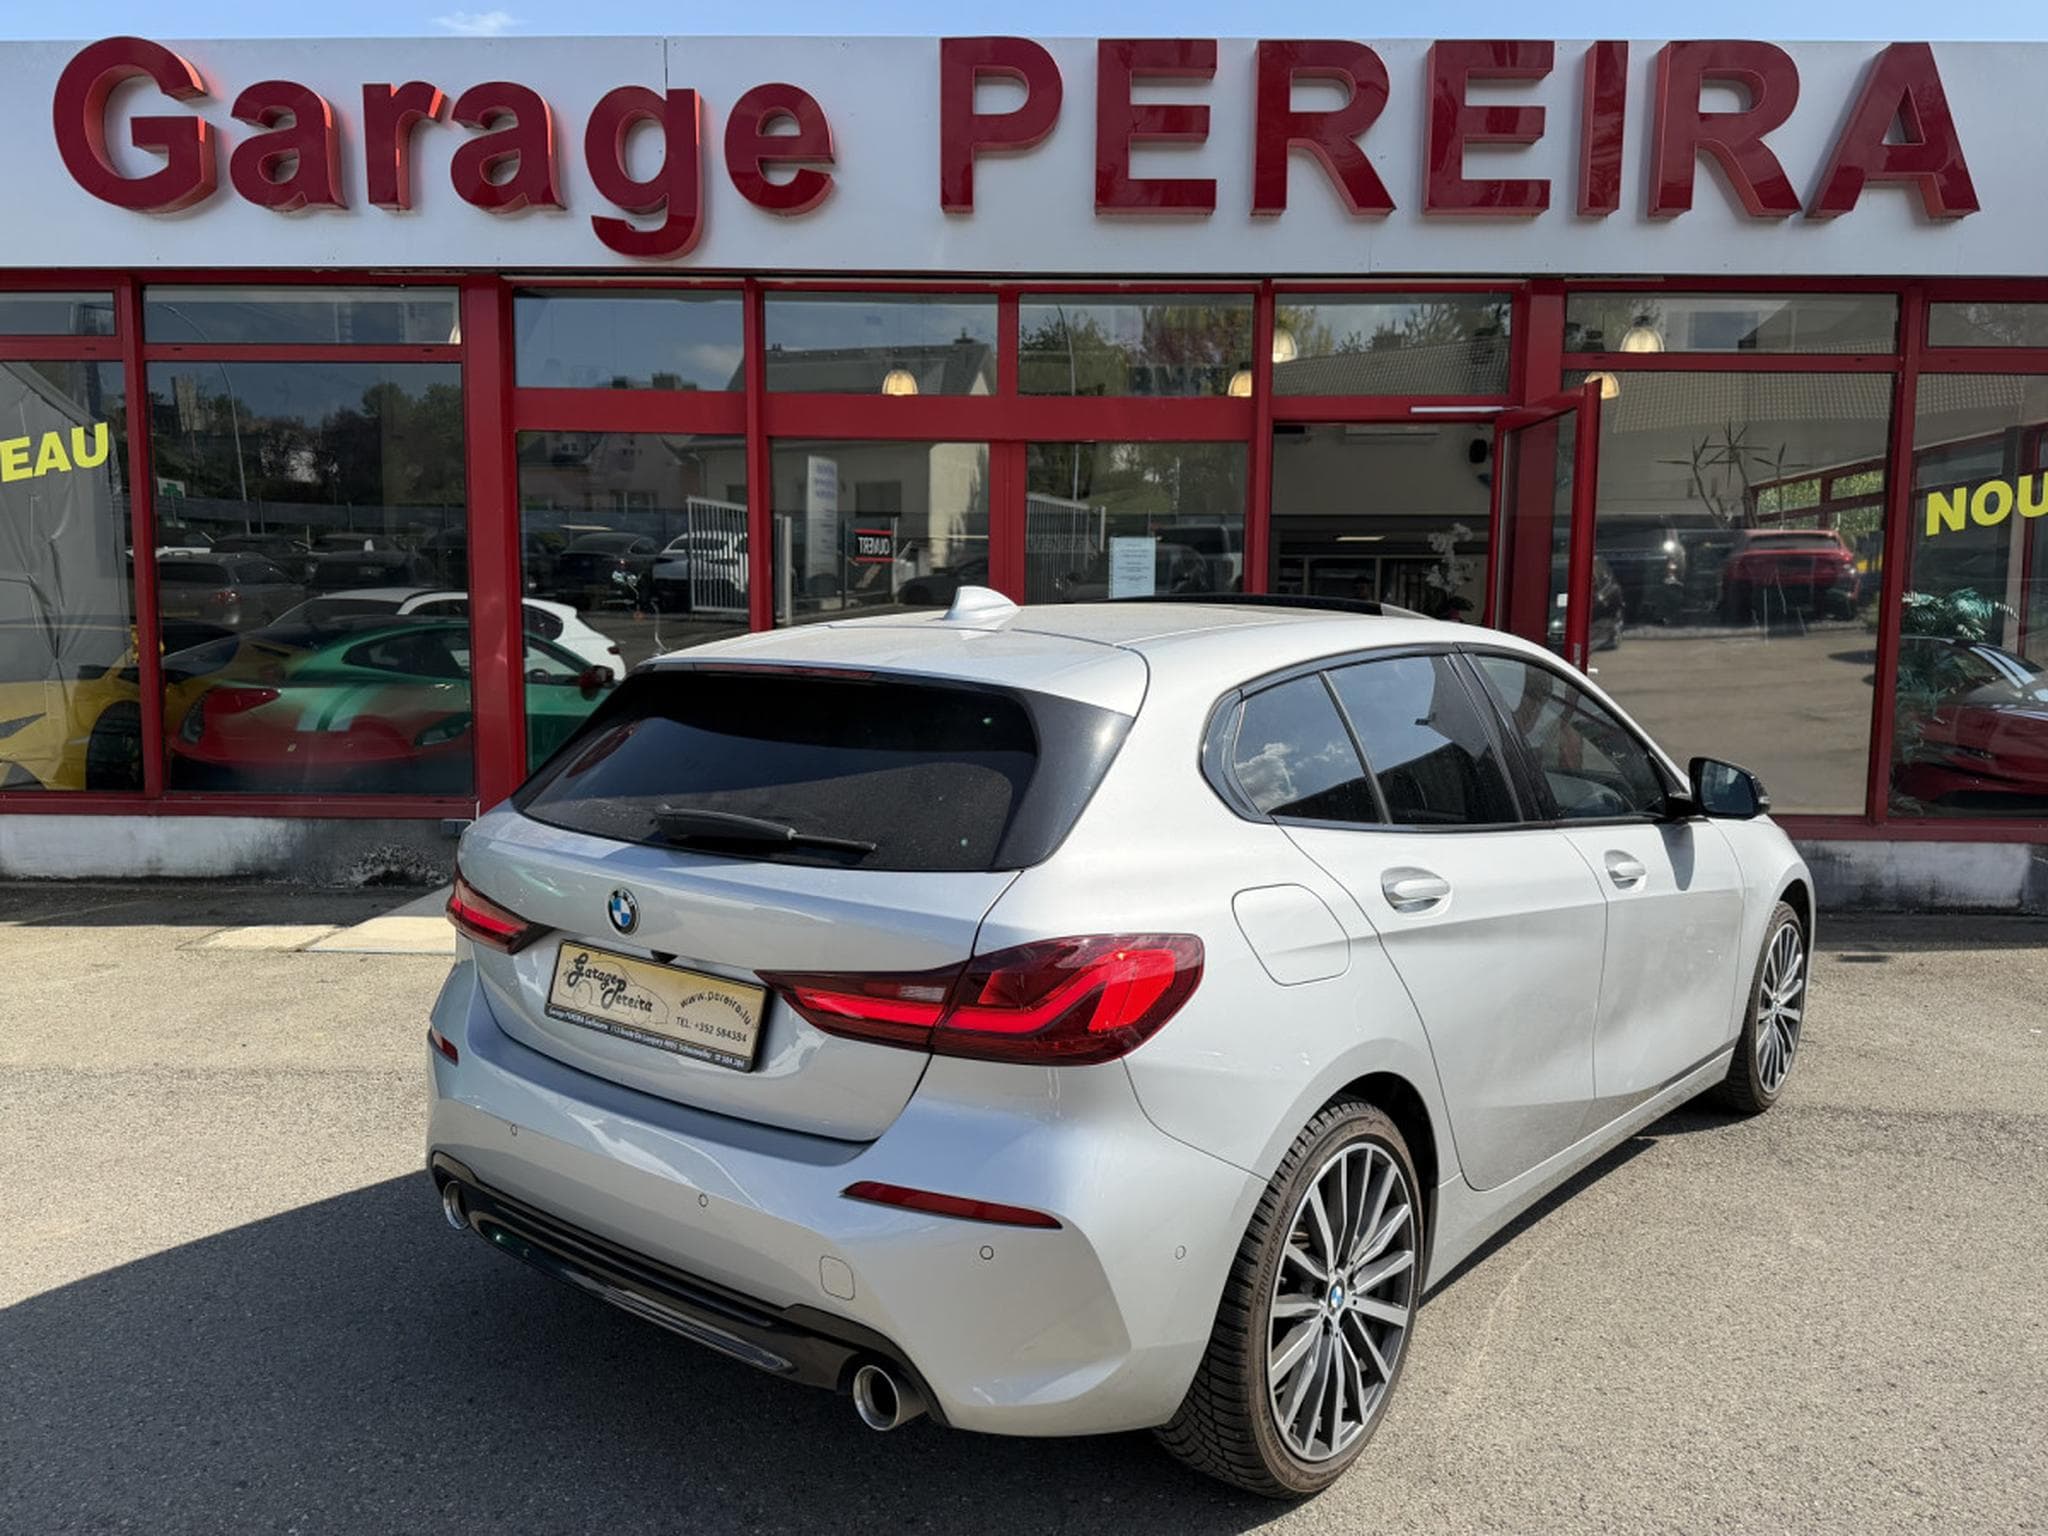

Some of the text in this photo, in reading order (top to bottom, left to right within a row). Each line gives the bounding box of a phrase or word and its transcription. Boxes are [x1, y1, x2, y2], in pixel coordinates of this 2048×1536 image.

[53, 36, 1981, 260] Garage PEREIRA
[0, 422, 109, 482] EAU
[1926, 471, 2048, 537] NOU
[567, 952, 618, 991] Garage
[601, 979, 653, 1012] Pereira
